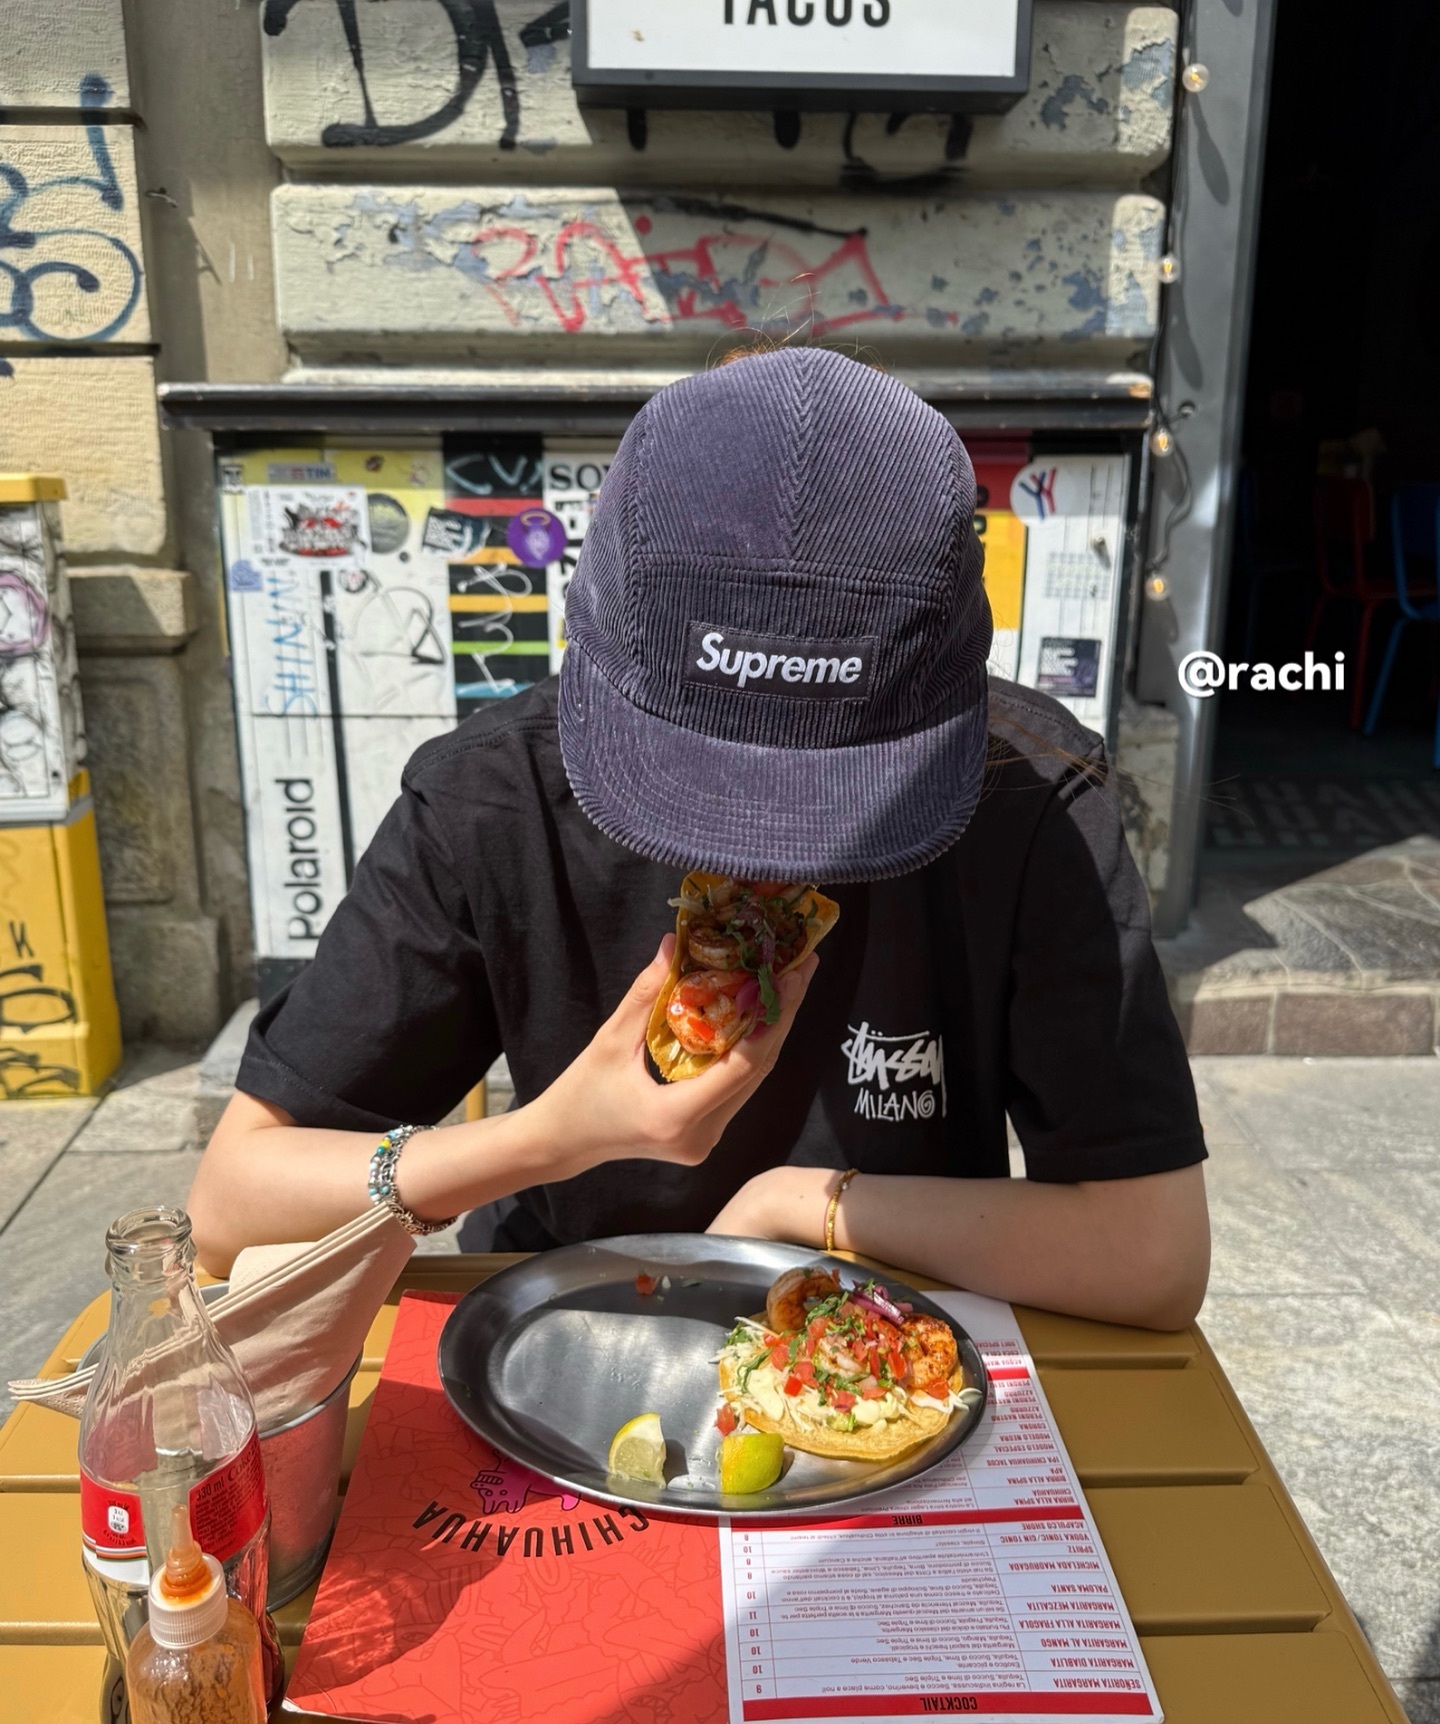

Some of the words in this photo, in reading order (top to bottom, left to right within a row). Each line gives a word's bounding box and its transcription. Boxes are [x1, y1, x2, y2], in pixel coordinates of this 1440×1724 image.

[696, 632, 863, 688] Supreme
[274, 777, 322, 941] Polaroid
[854, 1087, 935, 1121] MILANO
[1031, 1488, 1072, 1496] CHIHUAHUA
[892, 1515, 922, 1524] BIRRE
[412, 1500, 649, 1558] CHIHUAHUA
[1046, 1521, 1084, 1529] ACAPULCO
[1066, 1545, 1094, 1553] SPRITZ
[1008, 1562, 1056, 1570] MADRUGADA
[1056, 1561, 1099, 1569] MICHELADA
[1051, 1584, 1077, 1592] SANTA
[1077, 1584, 1108, 1593] PALOMA
[747, 1591, 756, 1599] 10
[1026, 1602, 1069, 1610] MEZCALITA
[1070, 1601, 1114, 1610] MARGARITA
[749, 1611, 757, 1619] 11
[1018, 1619, 1054, 1628] FRAGOLA
[1055, 1619, 1075, 1628] ALLA
[1076, 1619, 1120, 1628] MARGARITA
[749, 1628, 759, 1636] 10
[1040, 1638, 1070, 1647] MANGO
[1070, 1638, 1082, 1647] AL
[1081, 1638, 1127, 1648] MARGARITA
[751, 1646, 760, 1654] 10
[1050, 1657, 1087, 1667] DIABLITA
[1087, 1658, 1134, 1668] MARGARITA
[752, 1665, 762, 1674] 10
[1053, 1678, 1101, 1687] MARGARITA
[1101, 1678, 1142, 1689] SEÑORITA
[756, 1684, 762, 1693] 9
[919, 1696, 978, 1710] COCKTAIL
